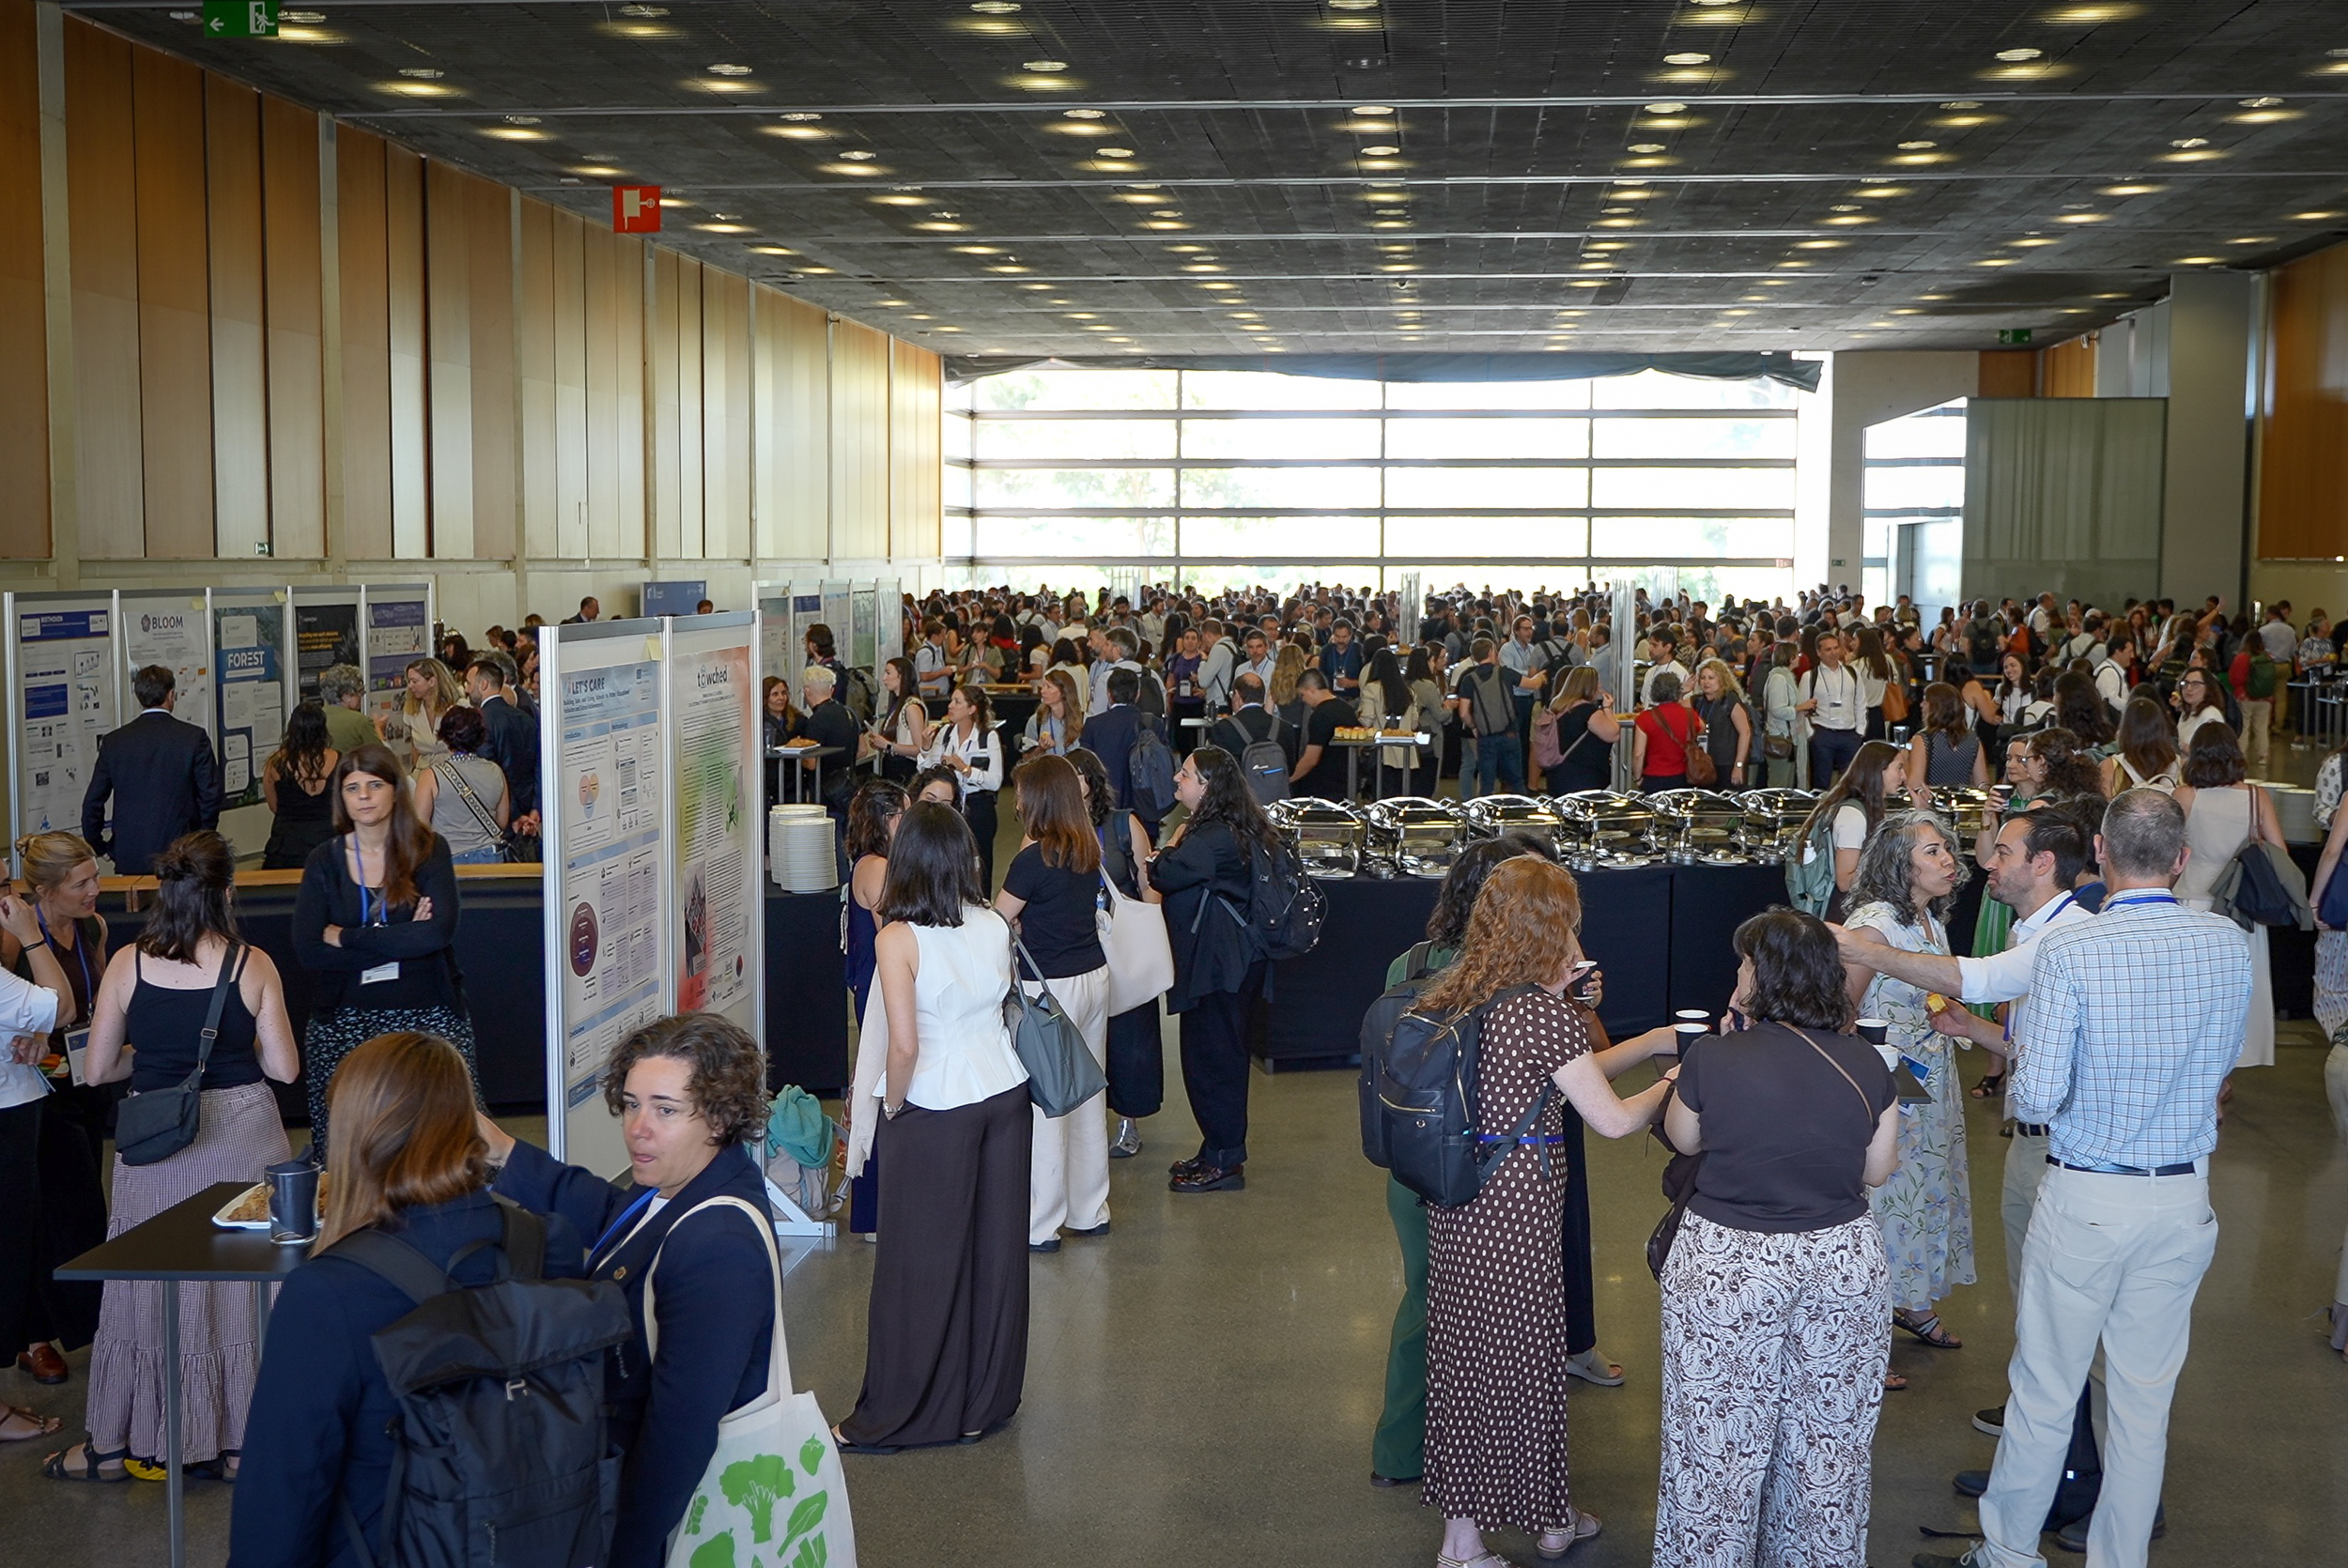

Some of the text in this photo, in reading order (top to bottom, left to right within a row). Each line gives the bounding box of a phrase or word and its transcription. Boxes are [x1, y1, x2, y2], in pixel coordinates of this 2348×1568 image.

[152, 616, 184, 629] BLOOM
[227, 651, 265, 668] FOREST
[589, 677, 605, 692] CARE
